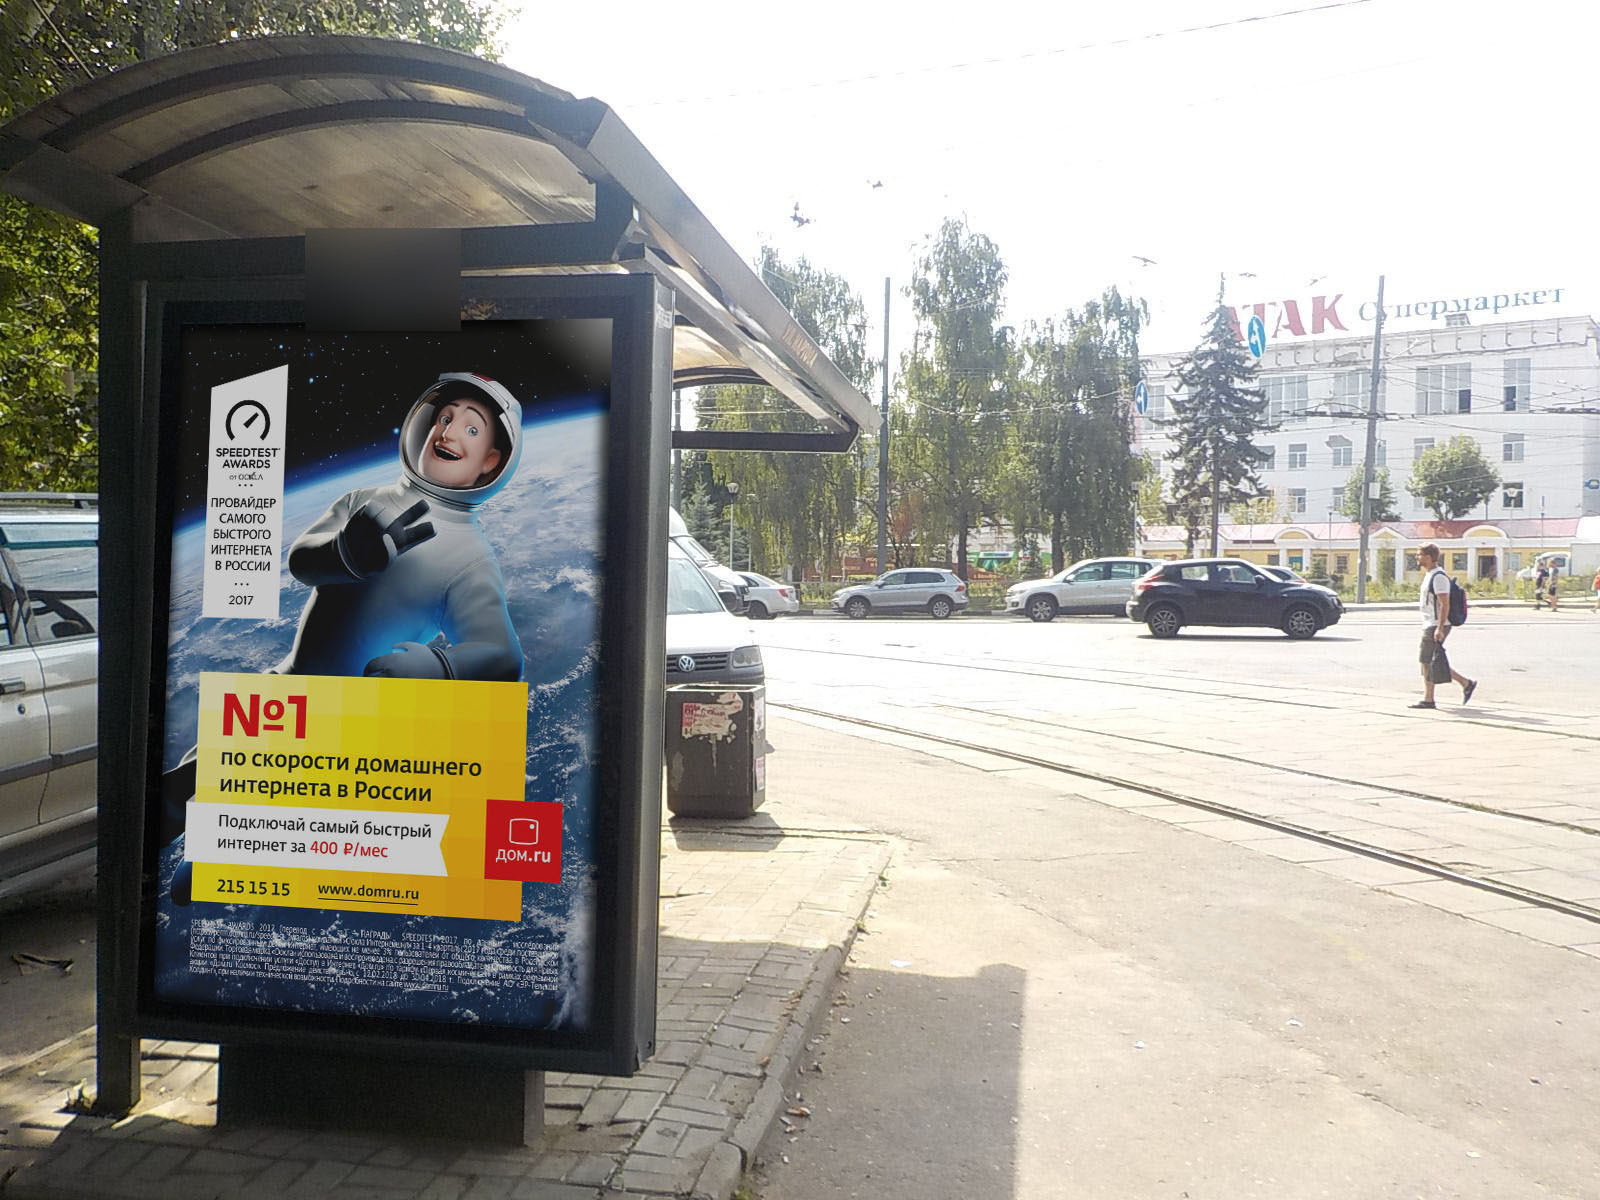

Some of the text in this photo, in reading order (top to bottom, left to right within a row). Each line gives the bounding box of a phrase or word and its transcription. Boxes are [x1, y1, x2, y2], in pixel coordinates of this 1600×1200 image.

[216, 448, 278, 457] SPEEDTEST
[222, 459, 271, 469] AWARDS
[211, 496, 277, 510] ПРОВАЙДЕР
[219, 513, 266, 524] САМОГО
[213, 529, 271, 540] БЫСТРОГО
[211, 544, 273, 556] ИНТЕРНЕТА
[215, 560, 271, 571] В РОССИИ
[228, 595, 254, 605] 2017
[221, 751, 482, 777] по скорости домашнего
[219, 778, 432, 802] интернета в России
[218, 814, 432, 840] Подключай самый быстрый
[217, 838, 287, 853] интернет
[290, 842, 306, 853] за
[310, 840, 338, 855] 400
[217, 879, 419, 900] 215 15 15 www.domru.ru
